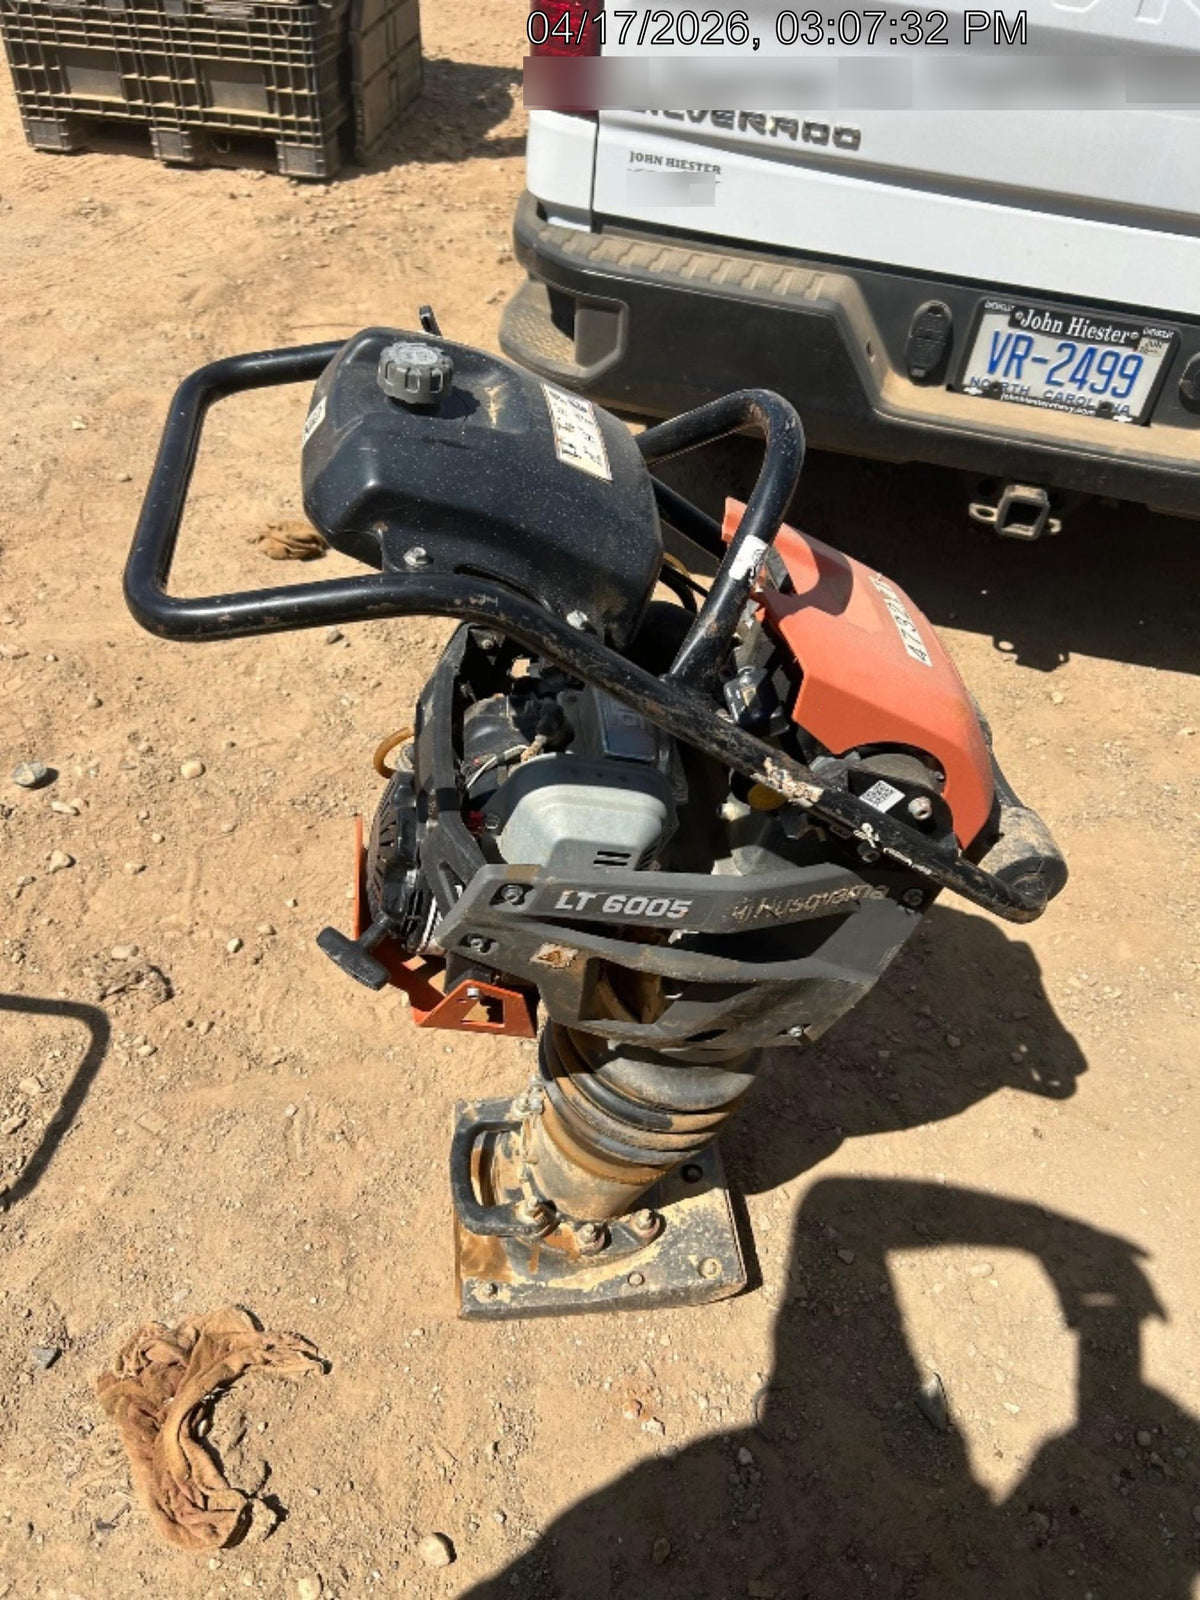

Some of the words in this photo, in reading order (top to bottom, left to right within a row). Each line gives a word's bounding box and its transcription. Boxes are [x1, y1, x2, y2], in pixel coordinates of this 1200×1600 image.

[629, 151, 663, 166] JOHN
[665, 157, 721, 175] HIESTER
[1020, 309, 1063, 333] John
[1066, 316, 1132, 344] Hiester
[986, 328, 1144, 399] VR-2499
[970, 376, 1030, 396] NORTH
[1043, 388, 1130, 415] CAROLNA
[553, 889, 598, 911] LT
[602, 894, 692, 920] 6005
